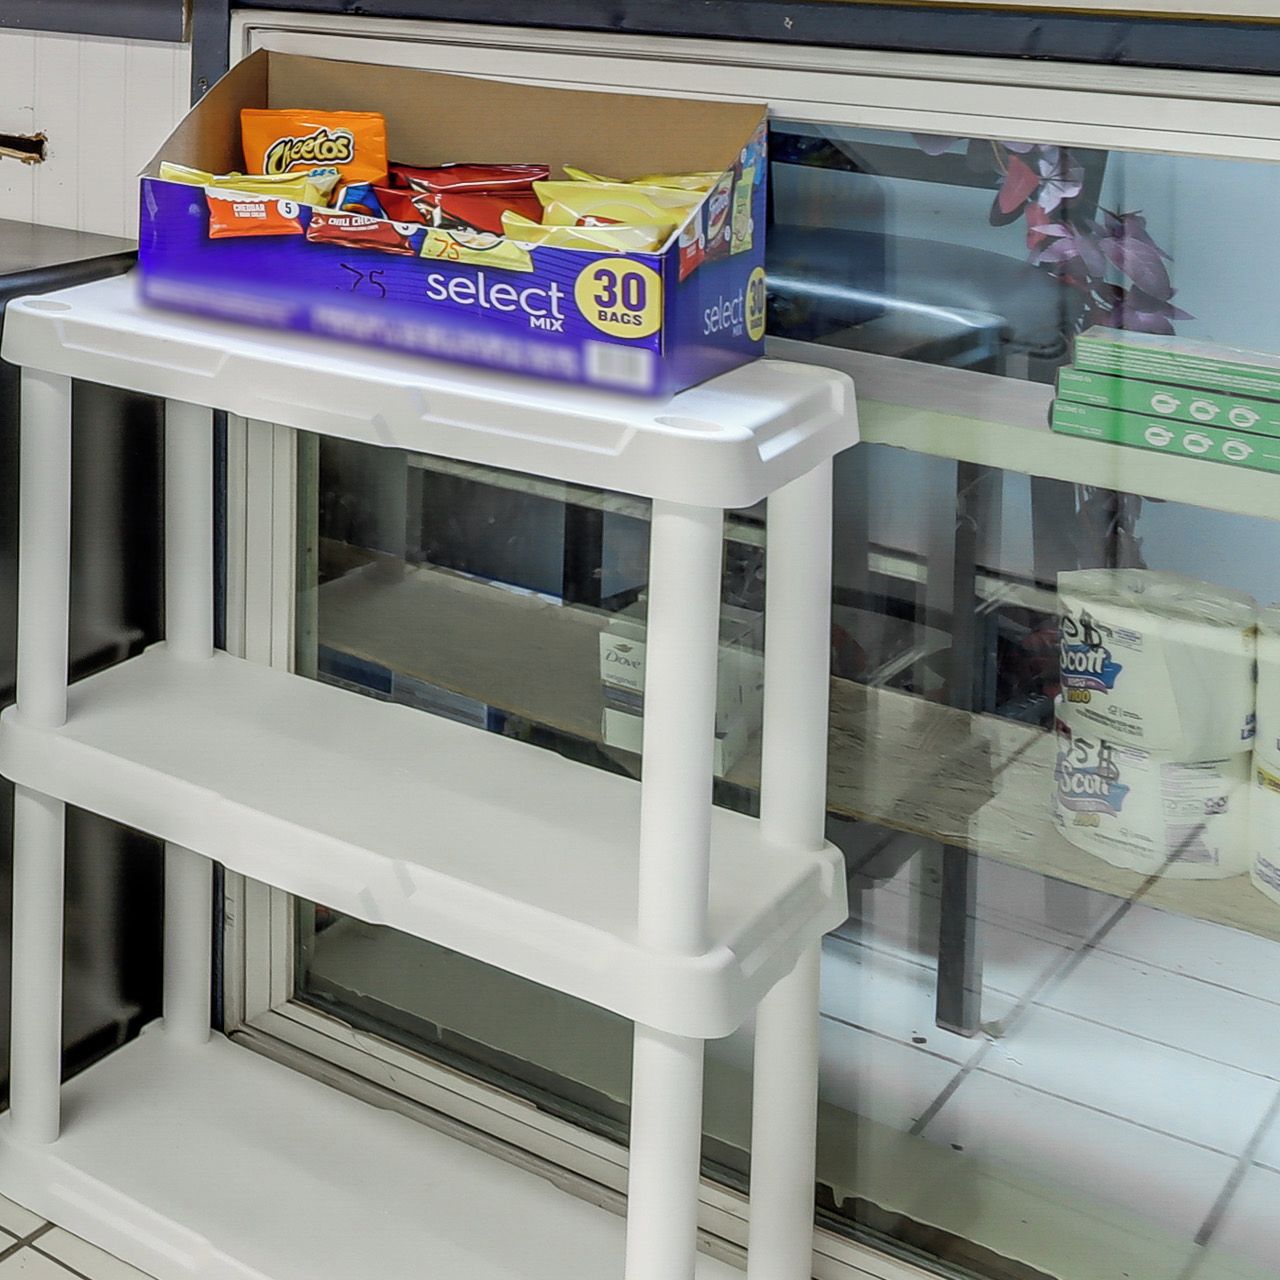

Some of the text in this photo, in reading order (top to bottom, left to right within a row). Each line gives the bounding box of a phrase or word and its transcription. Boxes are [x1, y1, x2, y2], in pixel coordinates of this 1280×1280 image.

[266, 128, 351, 175] Cheetos
[284, 202, 292, 215] 5
[425, 271, 566, 320] select
[593, 268, 647, 313] 30
[529, 315, 565, 333] MIX
[597, 309, 644, 327] BAGS
[703, 287, 744, 336] select
[605, 649, 641, 670] Dove
[1059, 638, 1107, 674] Scott
